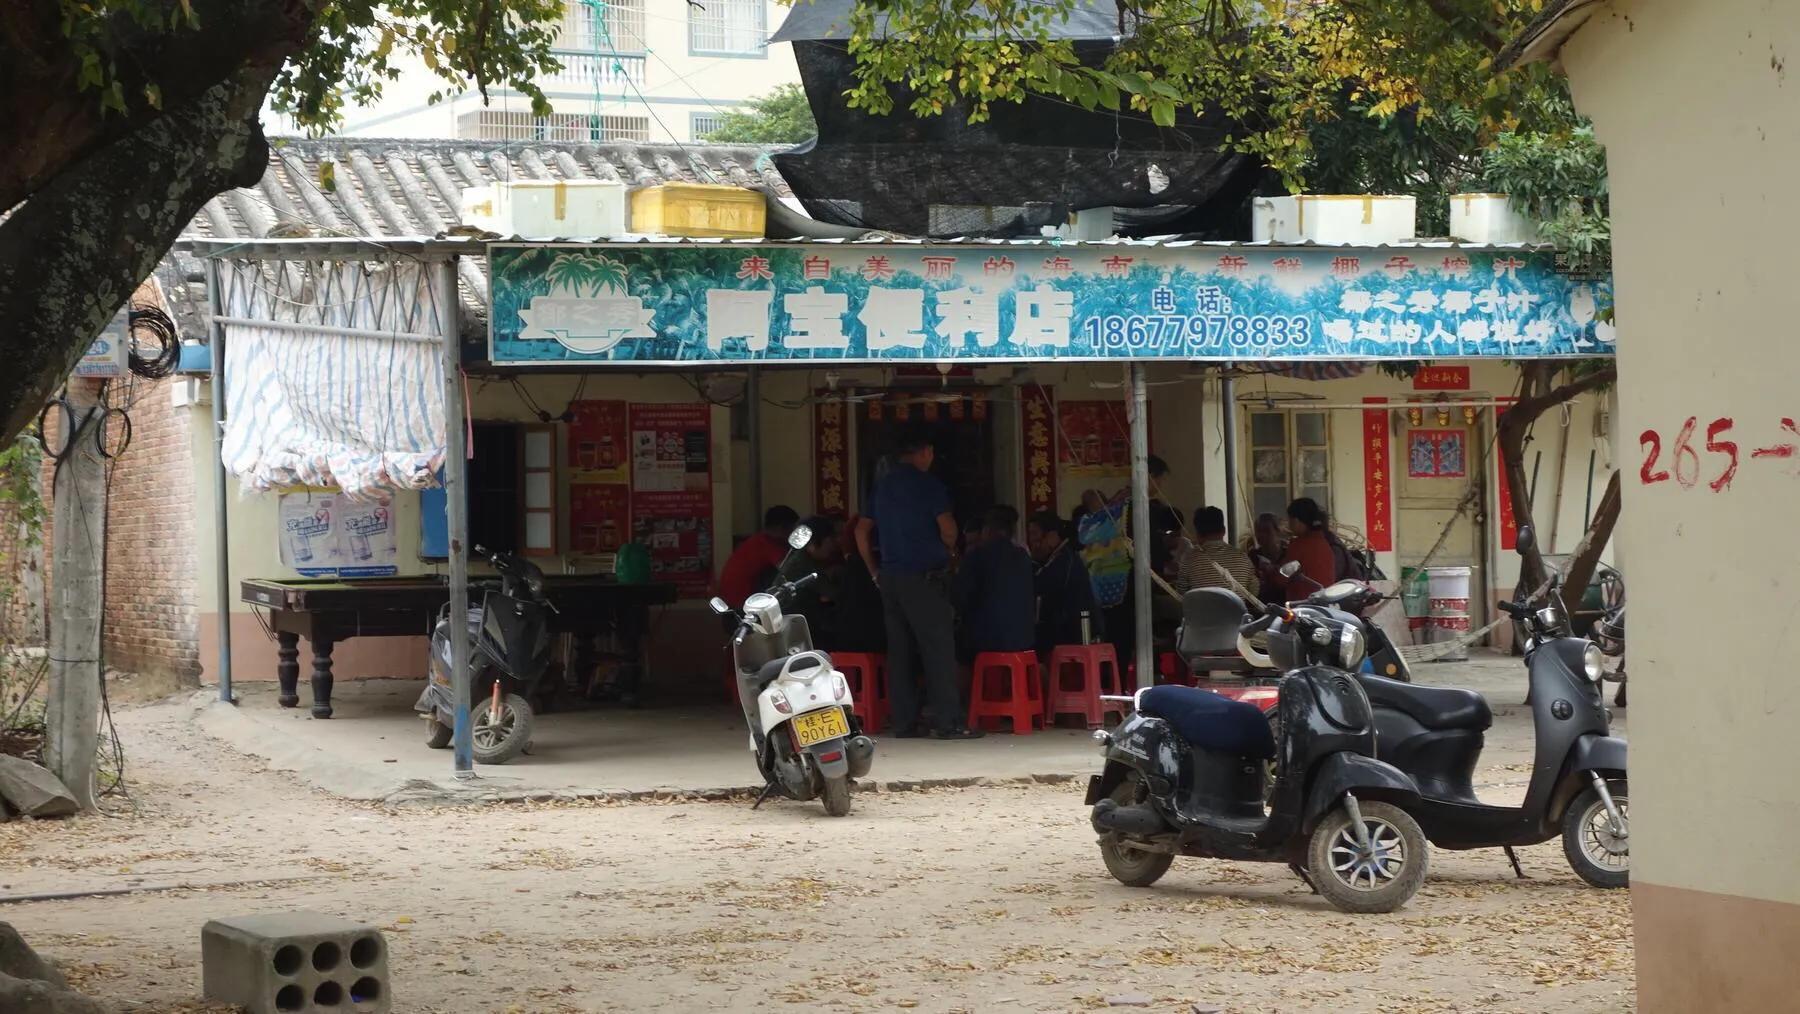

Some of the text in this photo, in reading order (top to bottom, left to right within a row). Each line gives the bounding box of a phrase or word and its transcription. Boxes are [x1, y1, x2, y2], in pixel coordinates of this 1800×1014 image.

[736, 255, 1134, 281] 来自美丽的海南
[1218, 254, 1526, 279] 新鲜椰子榨汁
[706, 285, 1075, 351] 阿宝便利店
[1085, 316, 1311, 349] 18677978833
[1639, 416, 1739, 493] 265
[801, 721, 843, 744] 90Y61
